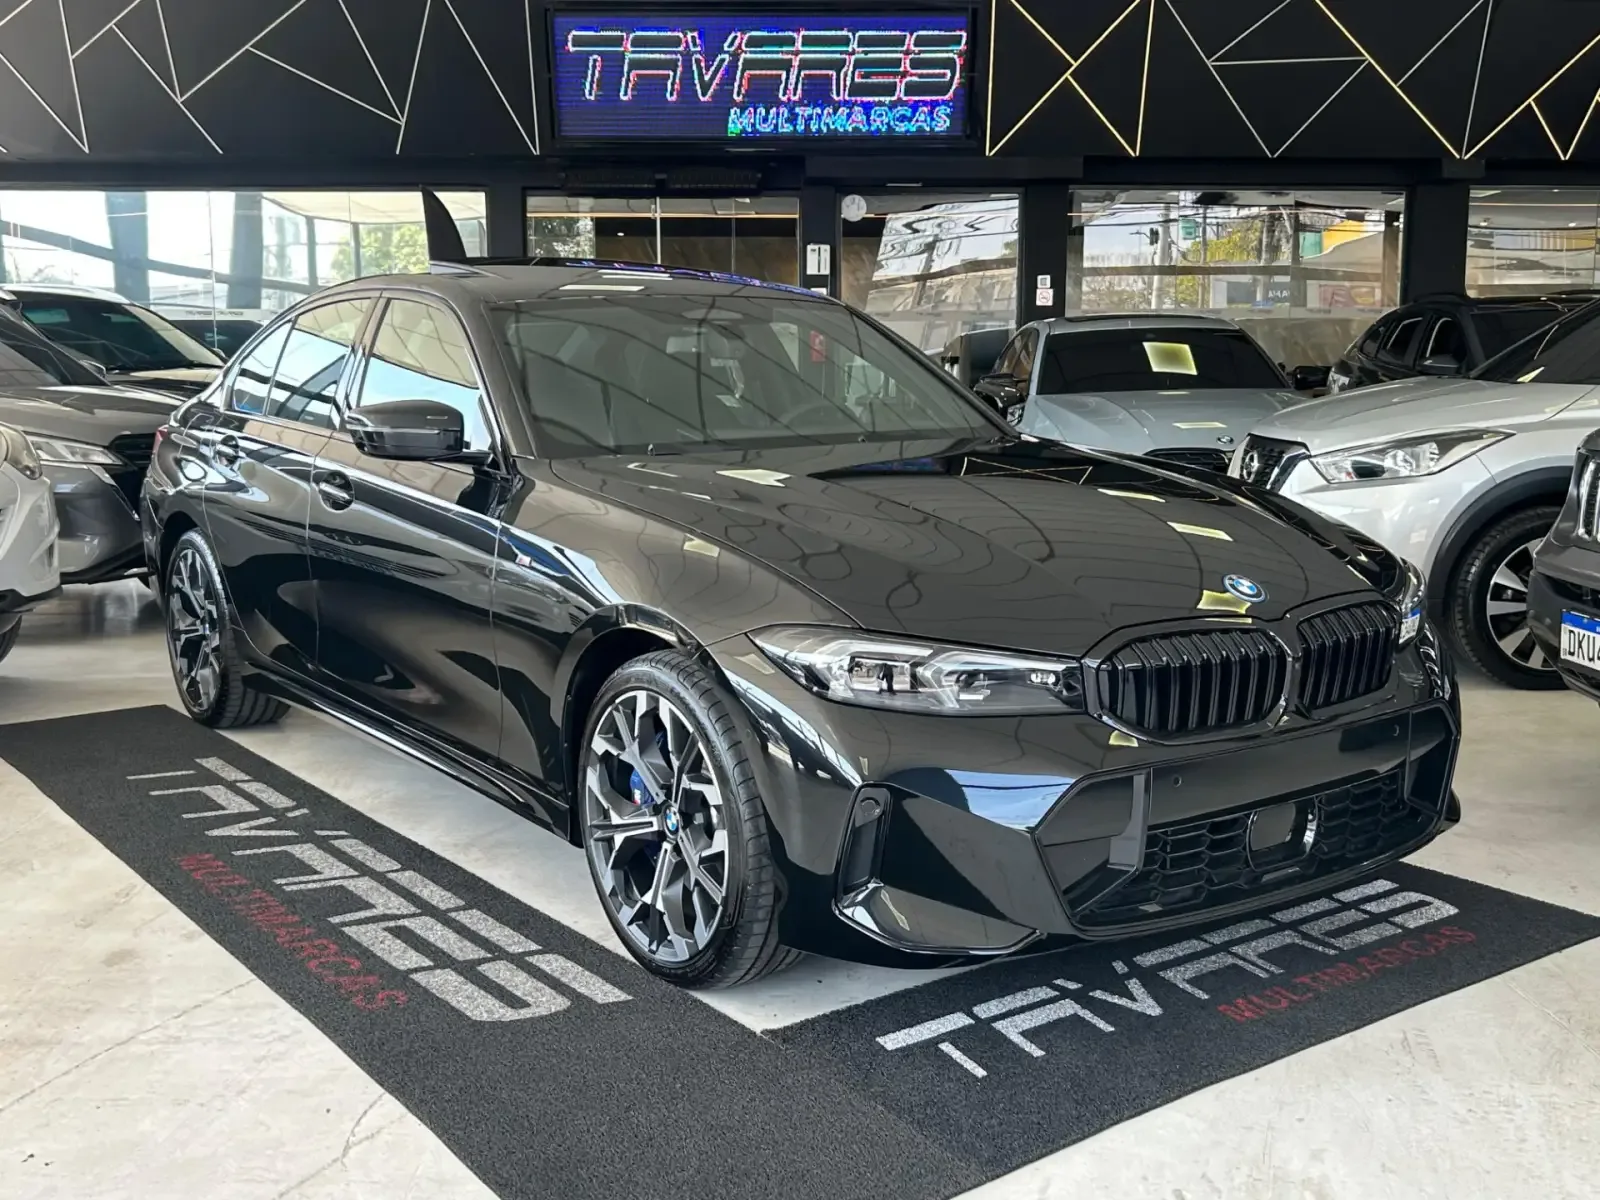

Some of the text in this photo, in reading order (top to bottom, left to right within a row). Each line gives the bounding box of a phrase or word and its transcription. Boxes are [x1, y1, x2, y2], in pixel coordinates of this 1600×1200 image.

[566, 29, 967, 102] TAVARES
[729, 105, 951, 132] MULTIMARCAS
[127, 756, 634, 1021] TAVARES
[178, 852, 408, 1011] MULTIMARCAS
[875, 879, 1460, 1078] TAVARES
[1218, 925, 1477, 1022] MULTIMARCAS
